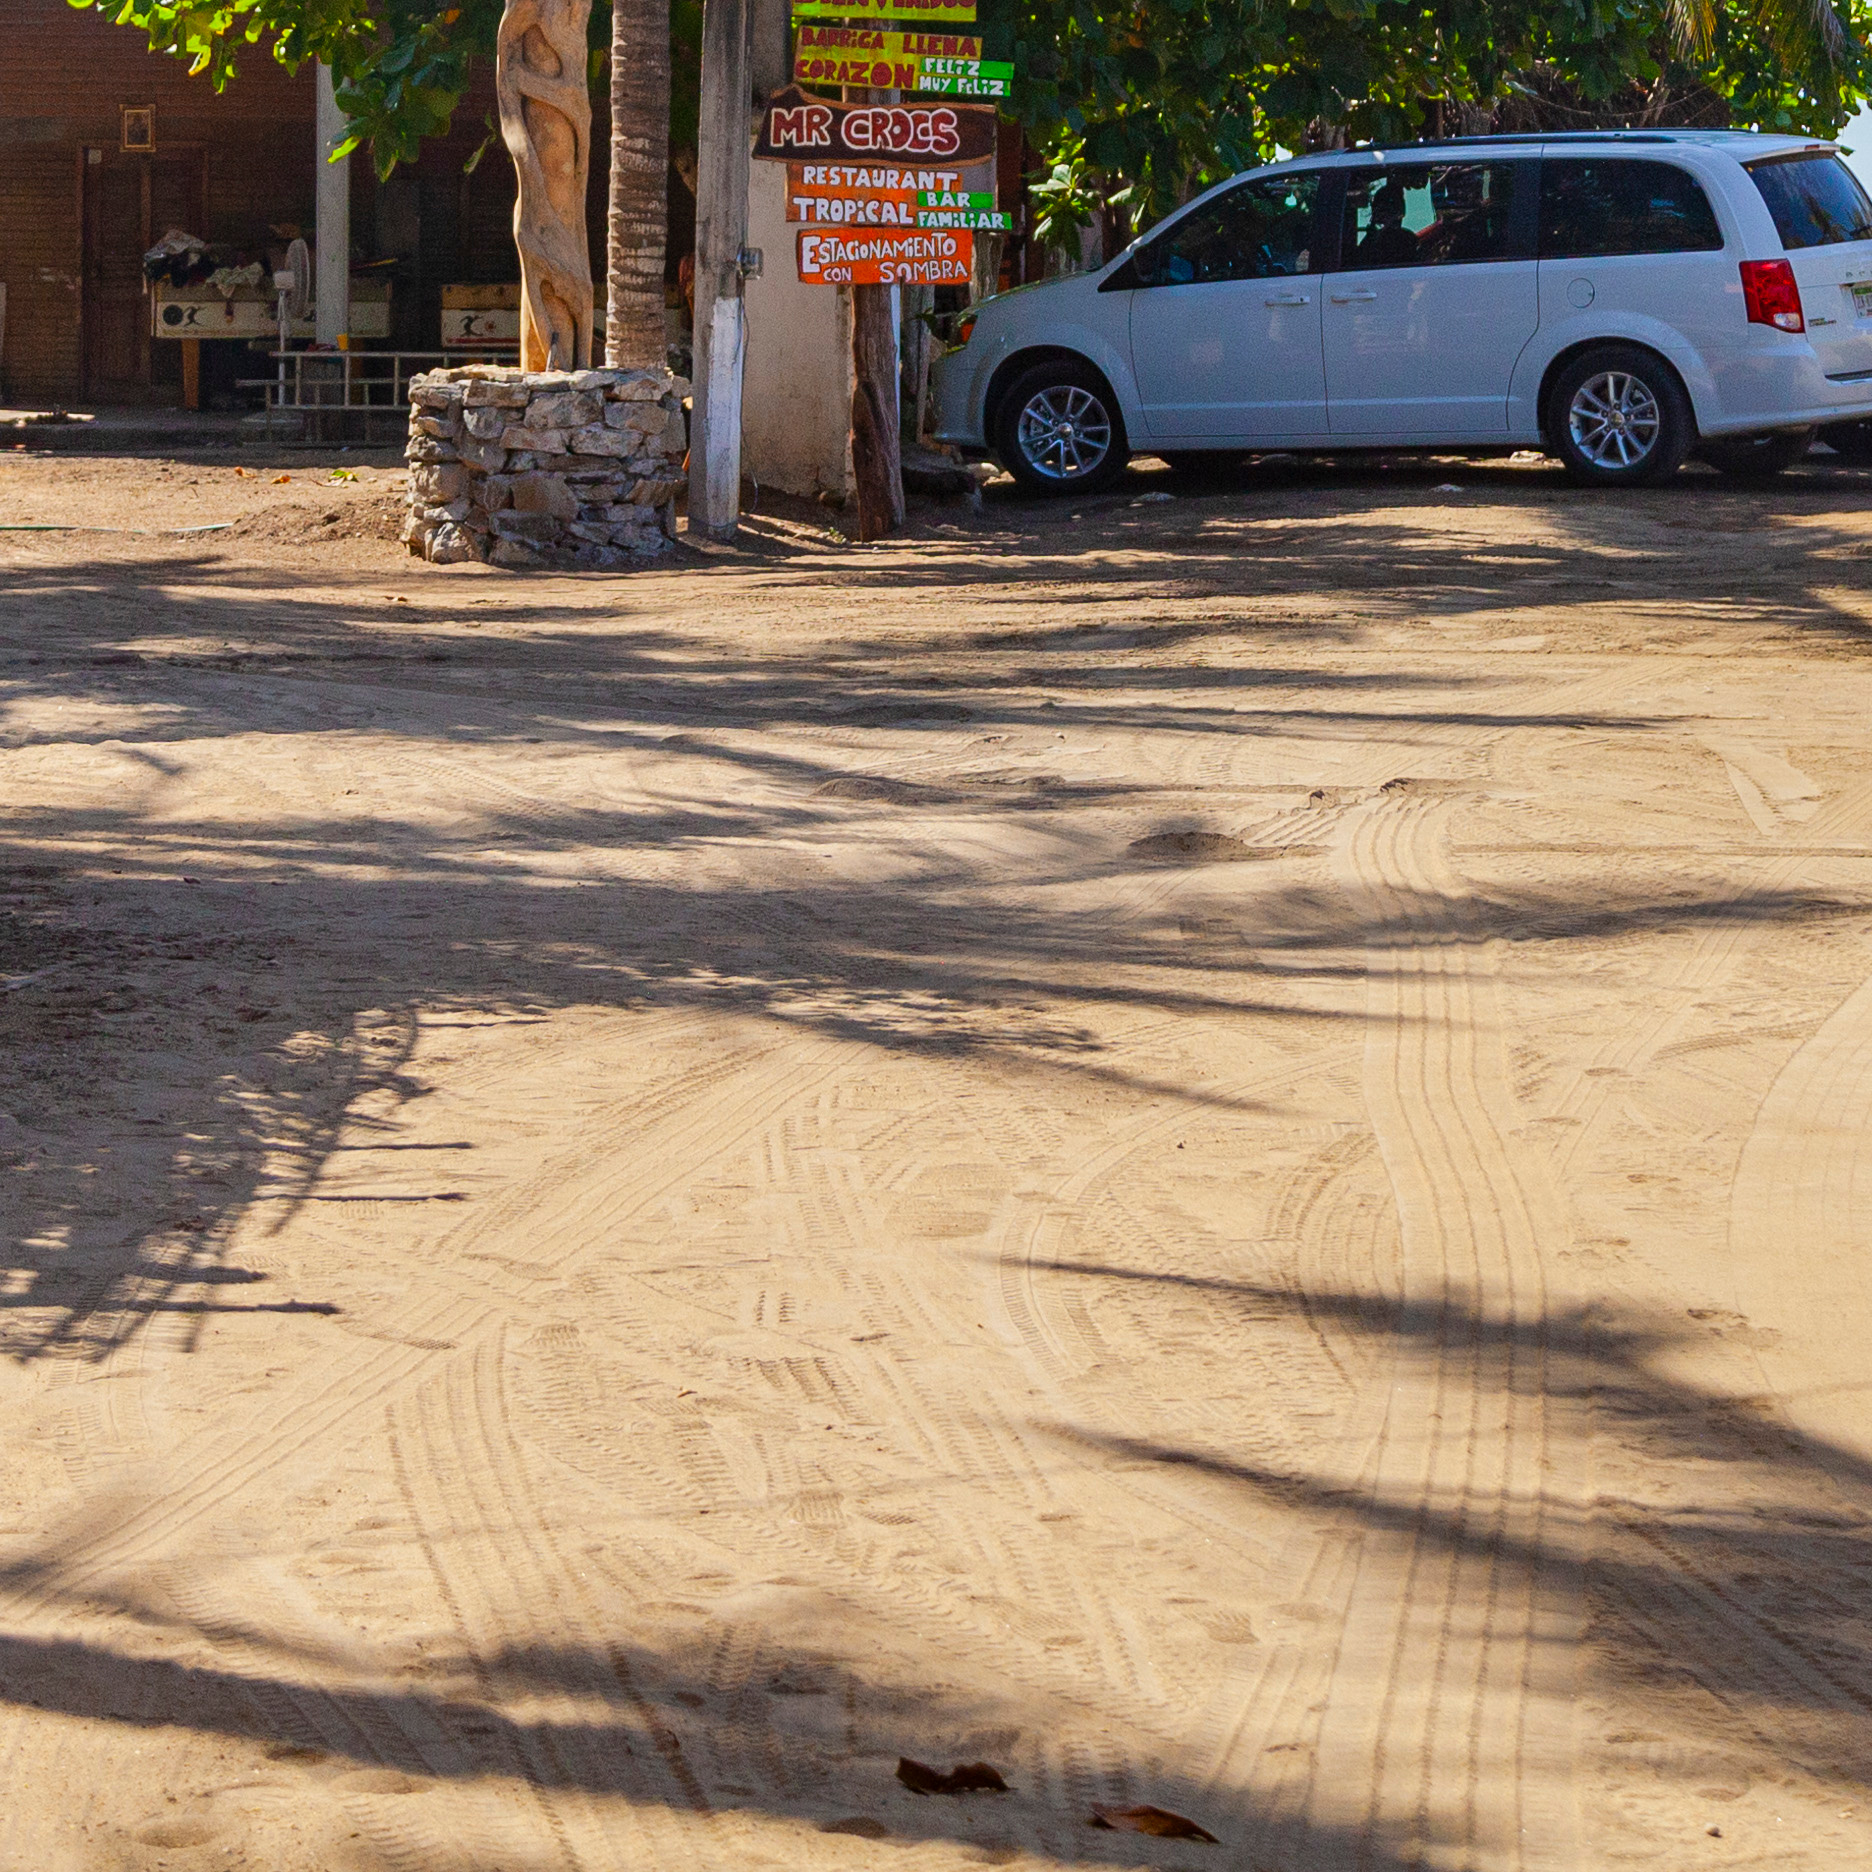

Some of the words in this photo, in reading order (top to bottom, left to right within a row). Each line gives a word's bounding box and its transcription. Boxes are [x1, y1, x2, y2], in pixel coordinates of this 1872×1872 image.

[902, 34, 977, 57] LLENA
[794, 59, 915, 88] CORAZON
[919, 76, 951, 92] MUY
[770, 105, 833, 147] MR
[841, 108, 961, 155] CROCS
[803, 165, 958, 191] RESTAURANT
[927, 191, 971, 208] BAR
[823, 266, 853, 282] CON
[879, 260, 968, 283] SOMBRA
